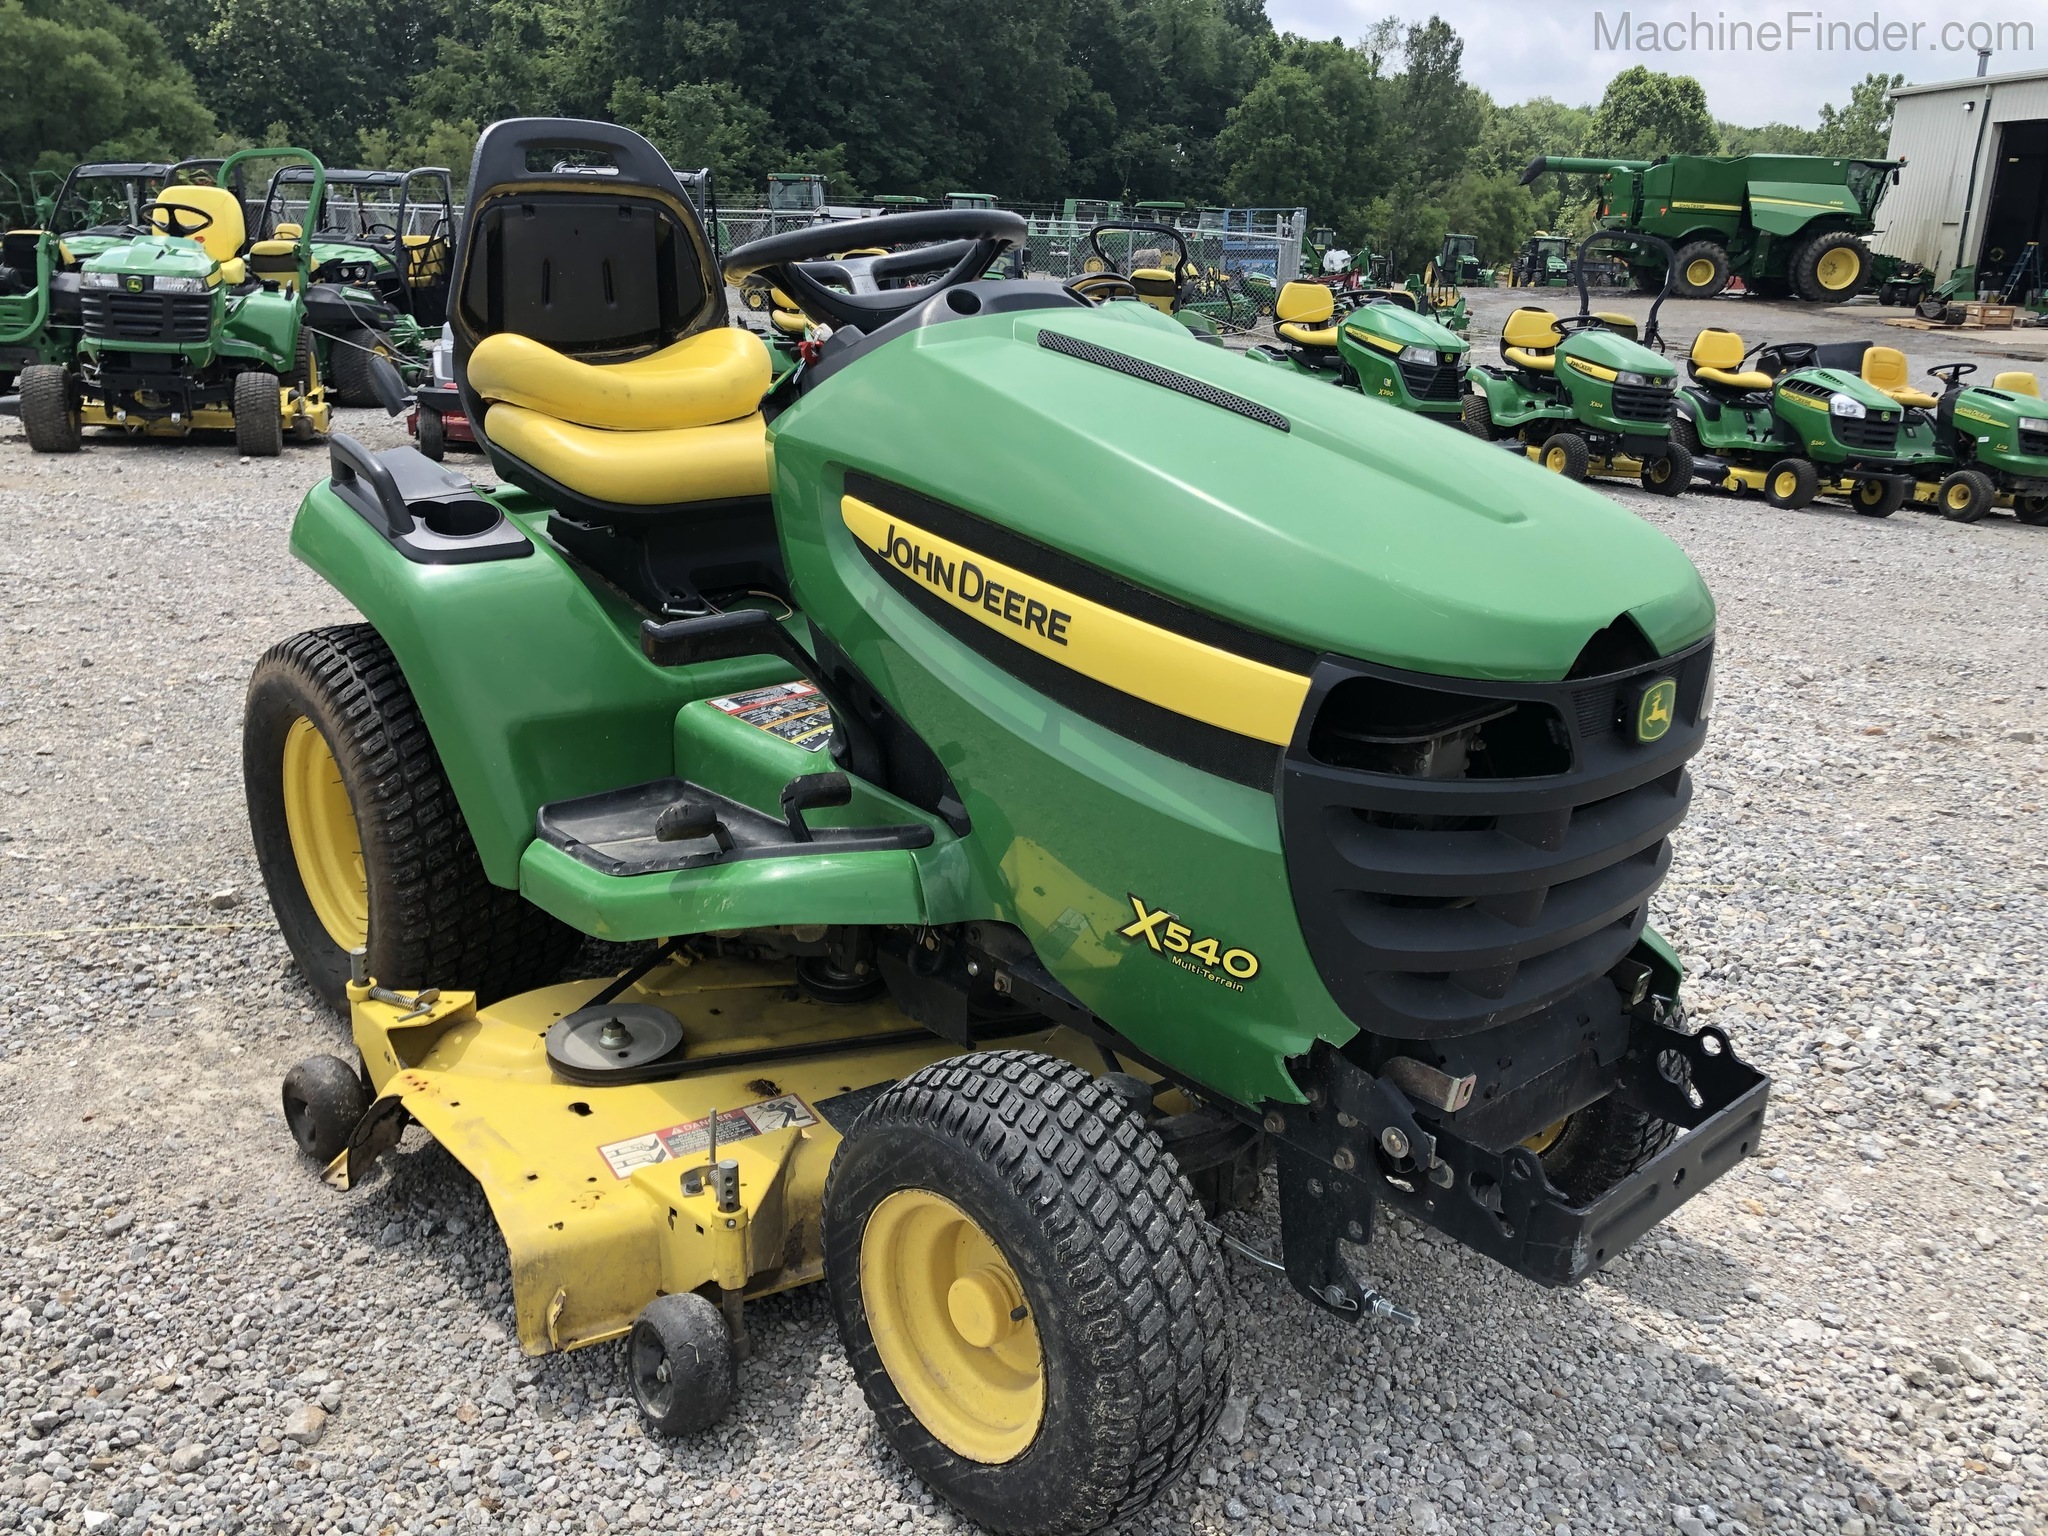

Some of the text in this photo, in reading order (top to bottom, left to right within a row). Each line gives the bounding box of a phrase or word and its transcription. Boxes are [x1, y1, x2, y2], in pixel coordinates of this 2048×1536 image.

[877, 524, 1071, 646] JOHN DEERE
[1119, 895, 1260, 981] X540
[1171, 955, 1245, 993] Multi-Terrain
[683, 1112, 733, 1131] DANER
